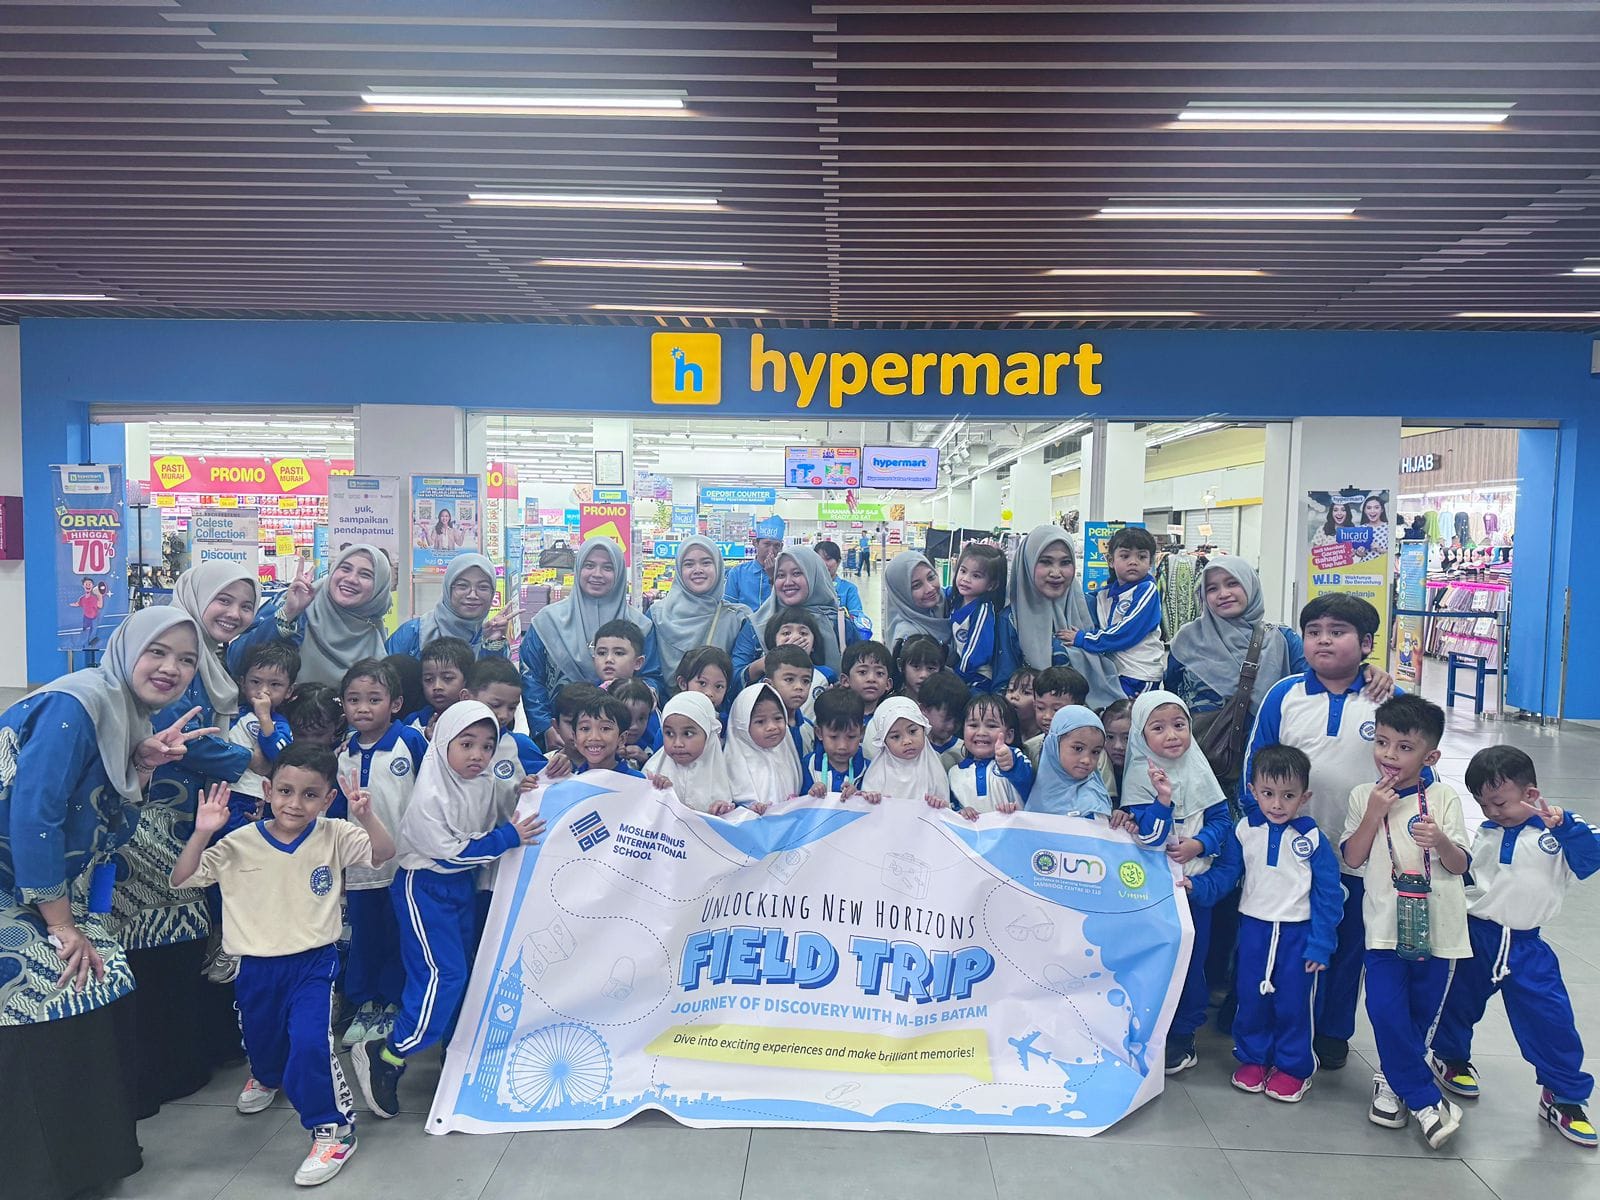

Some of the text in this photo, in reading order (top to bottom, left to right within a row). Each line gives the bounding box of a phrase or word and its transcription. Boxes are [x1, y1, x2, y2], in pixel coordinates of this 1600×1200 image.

[750, 333, 1103, 408] hypermart
[161, 464, 185, 473] PASTI
[872, 457, 927, 468] hypermart
[1401, 454, 1434, 473] HIJAB
[210, 467, 266, 482] PROMO
[279, 466, 304, 474] PASTI
[354, 505, 374, 514] yuk,
[583, 506, 627, 516] PROMO
[60, 514, 121, 527] OBRAL
[195, 517, 233, 528] Celeste
[339, 516, 389, 525] sampaikan
[195, 528, 246, 539] Collection
[333, 526, 394, 536] pendapatmu!
[1341, 529, 1369, 540] hicard
[73, 540, 114, 573] 70%
[200, 550, 247, 560] Discount
[1312, 573, 1341, 585] W.I.B
[619, 823, 686, 848] MOSLEM BINUS
[616, 833, 688, 860] INTERNATIONAL
[613, 845, 653, 861] SCHOOL
[702, 891, 810, 923] UNLOCKING
[876, 900, 975, 940] HORIZONS
[677, 925, 996, 1004] FIELD TRIP
[671, 995, 988, 1027] JOURNEY OF DISCOVERY WITH M-BIS BATAM
[673, 1033, 975, 1062] Dive into exciting experiences and make brilliant memories!
